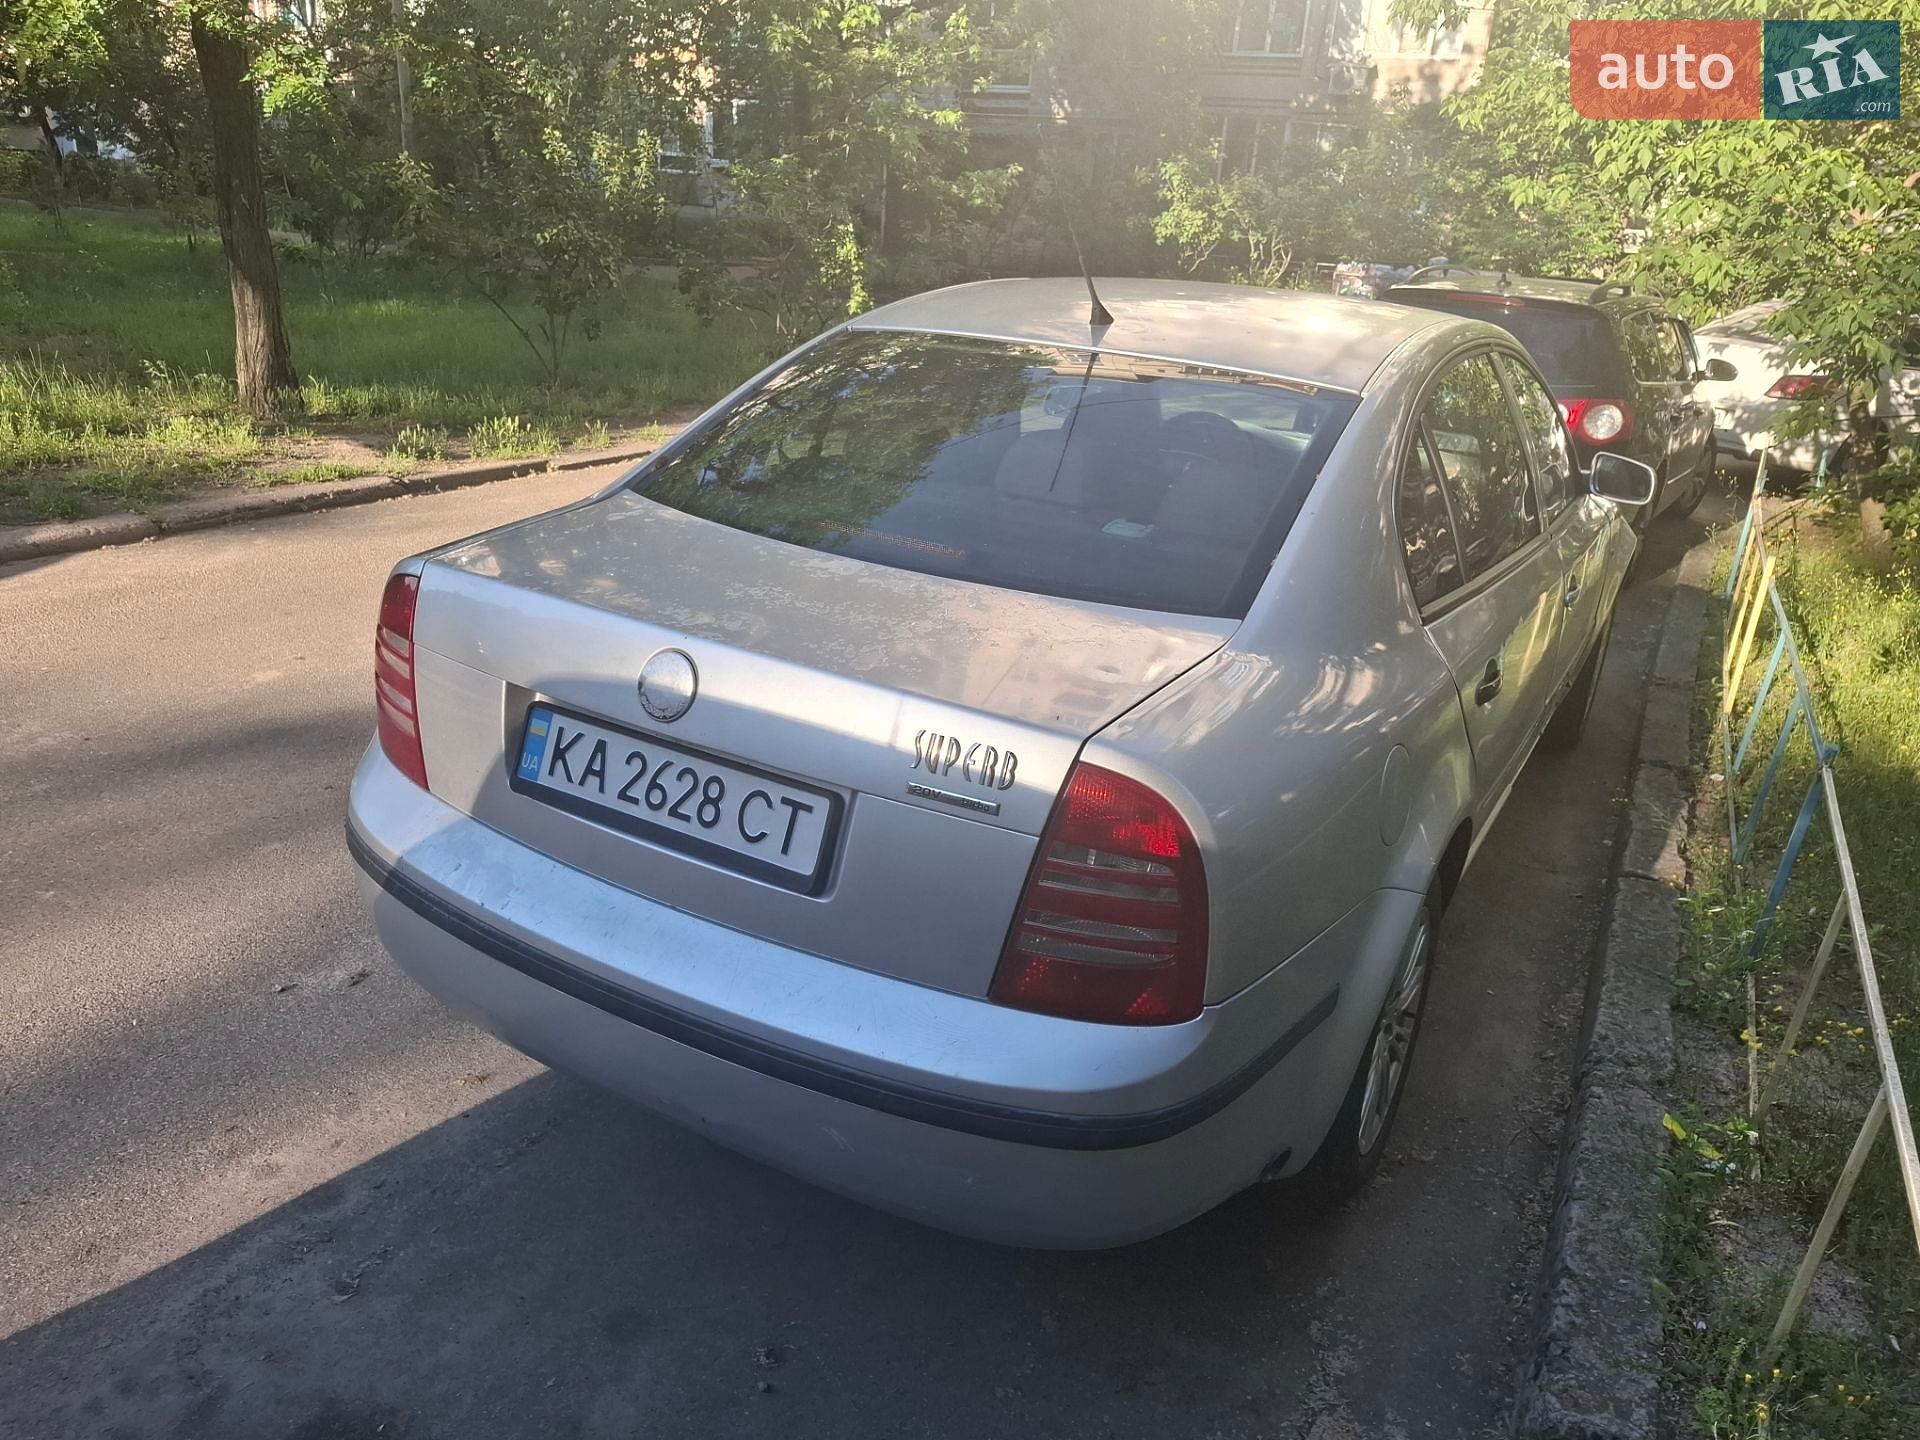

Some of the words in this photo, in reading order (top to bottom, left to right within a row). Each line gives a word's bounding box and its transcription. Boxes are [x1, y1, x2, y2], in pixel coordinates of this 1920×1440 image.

[521, 752, 538, 772] UA
[909, 729, 1018, 790] SUPERB
[548, 726, 606, 794] KA
[616, 750, 726, 829] 2628
[737, 789, 814, 856] CT
